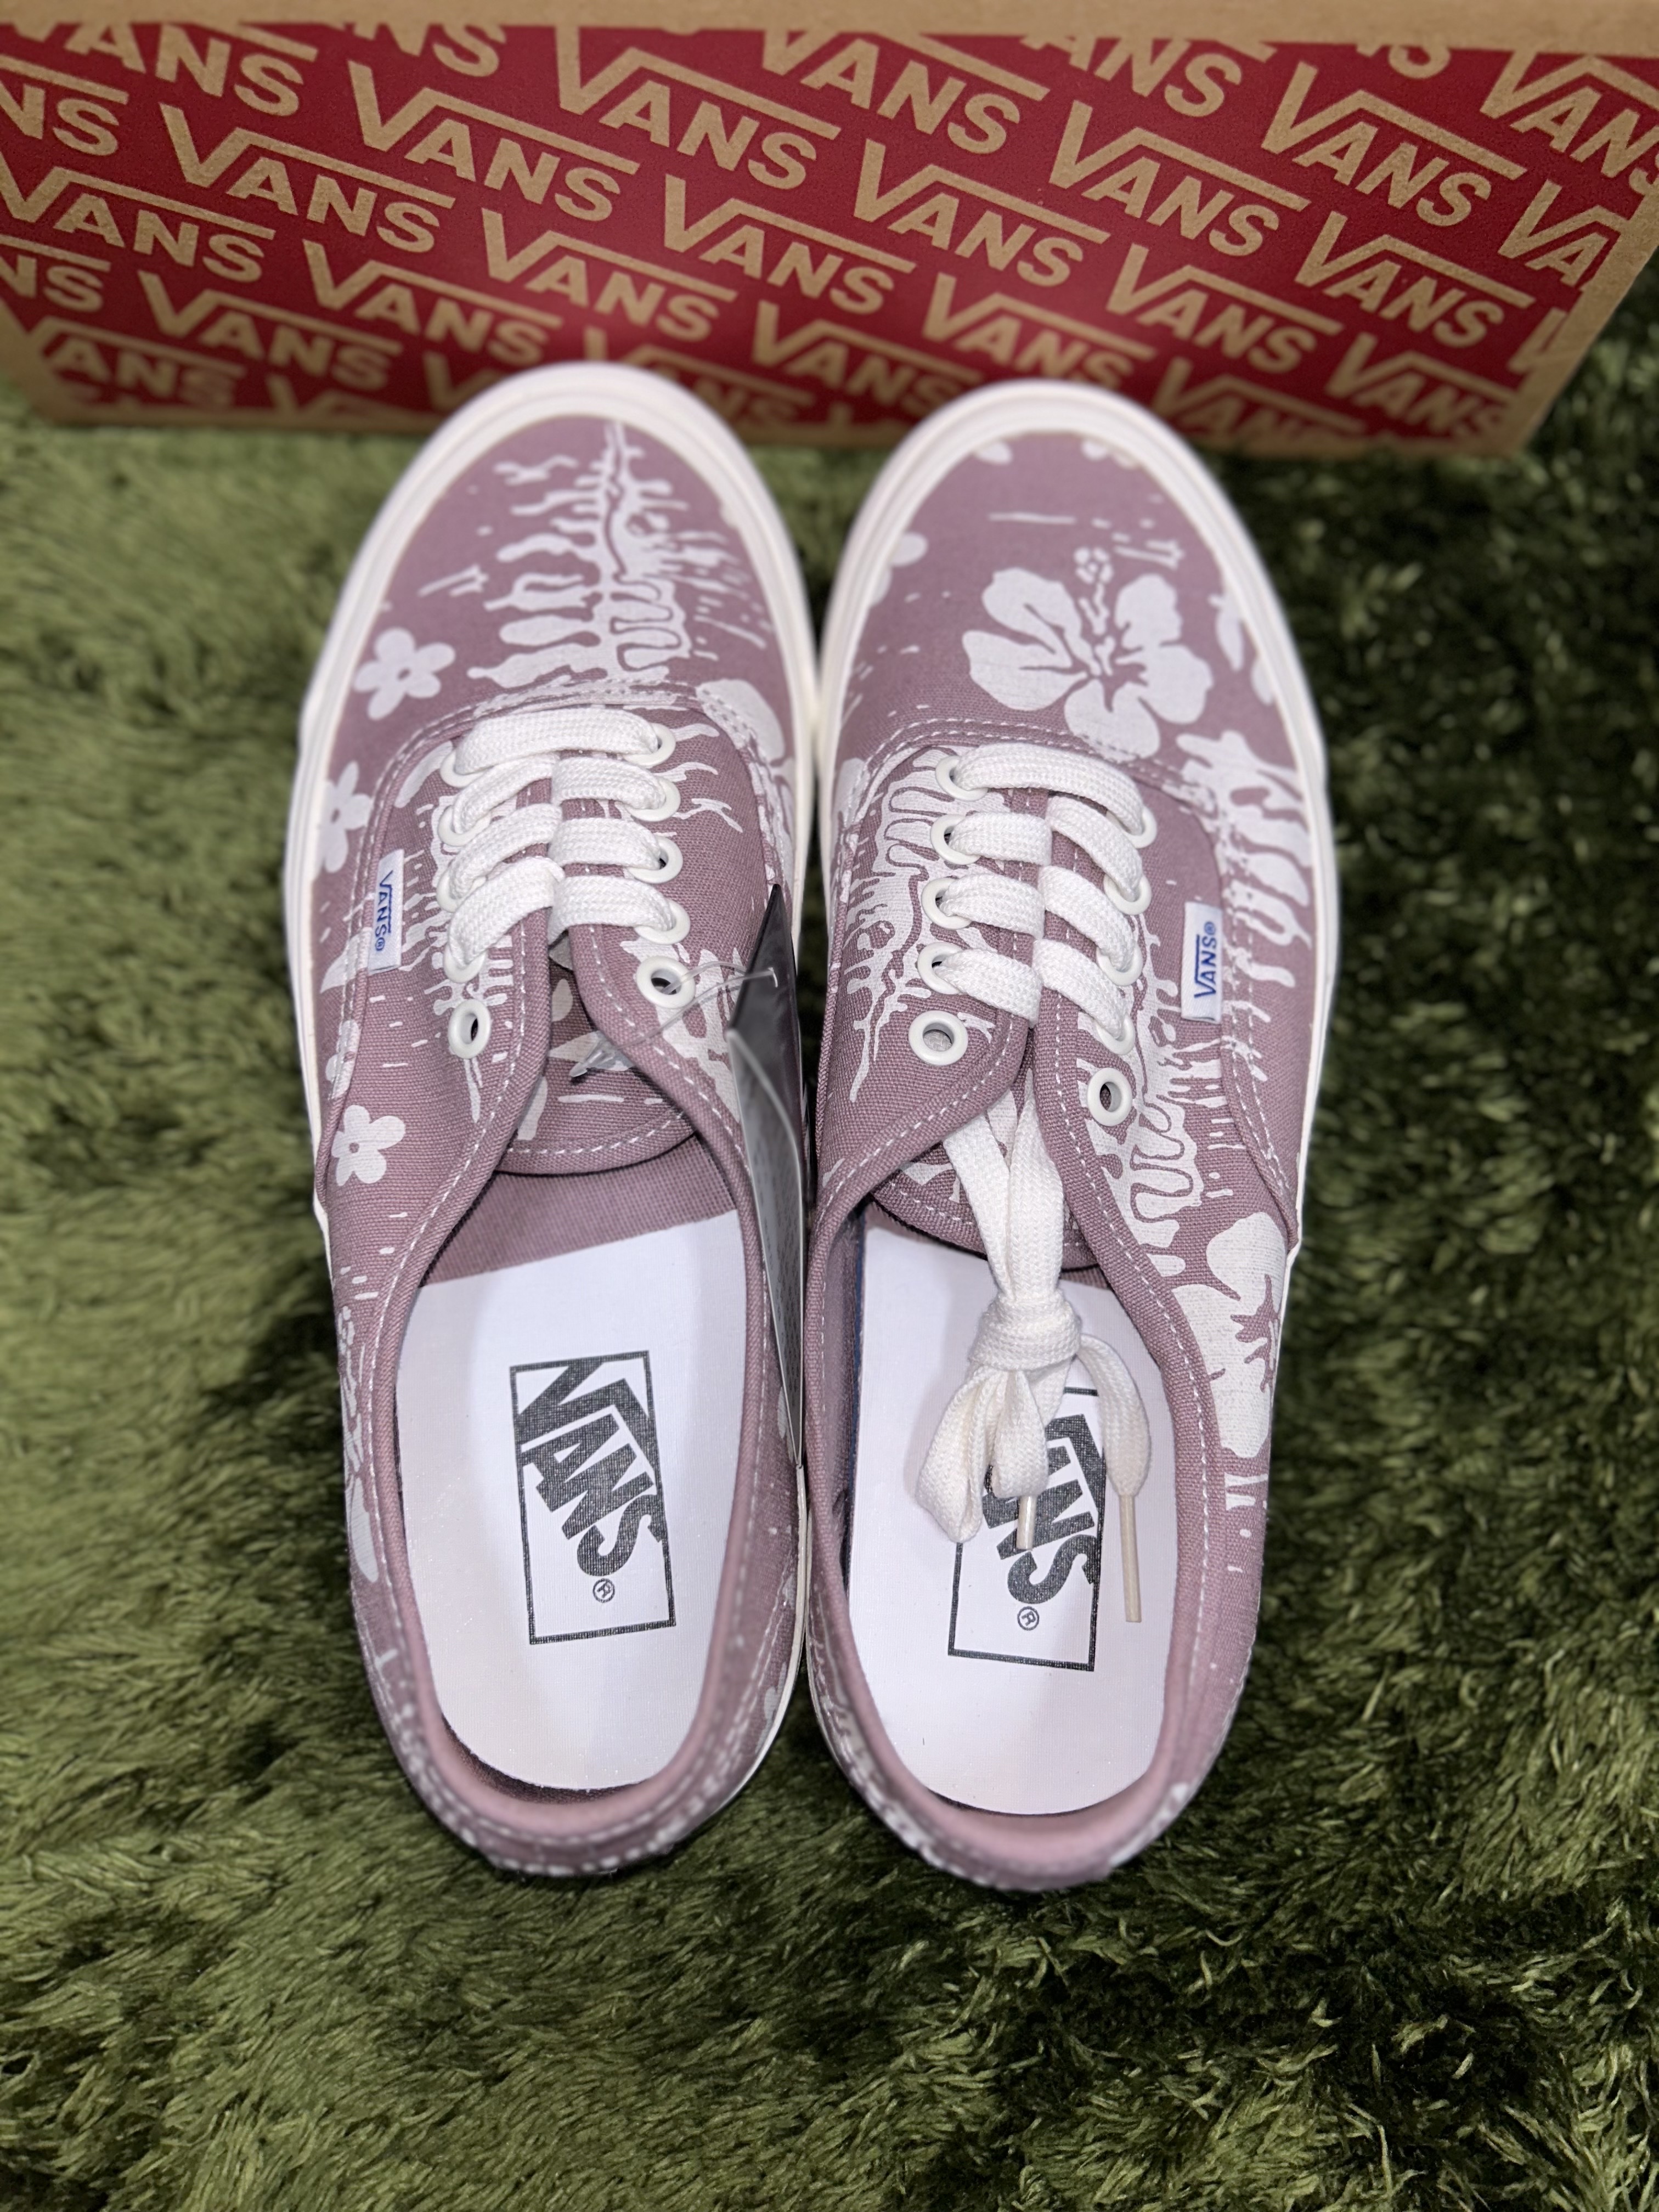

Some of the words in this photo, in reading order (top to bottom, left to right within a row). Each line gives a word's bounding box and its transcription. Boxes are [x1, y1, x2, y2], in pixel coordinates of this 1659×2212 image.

[159, 103, 456, 252] VANS
[348, 60, 640, 222] VANS
[554, 26, 842, 190] VANS
[1048, 99, 1312, 257] VANS
[1260, 60, 1528, 227] VANS
[482, 207, 738, 342] VANS
[664, 174, 917, 314] VANS
[854, 138, 1111, 287] VANS
[1294, 210, 1536, 348] VANS
[138, 269, 403, 391] VANS
[303, 238, 563, 366] VANS
[1107, 242, 1344, 375] VANS
